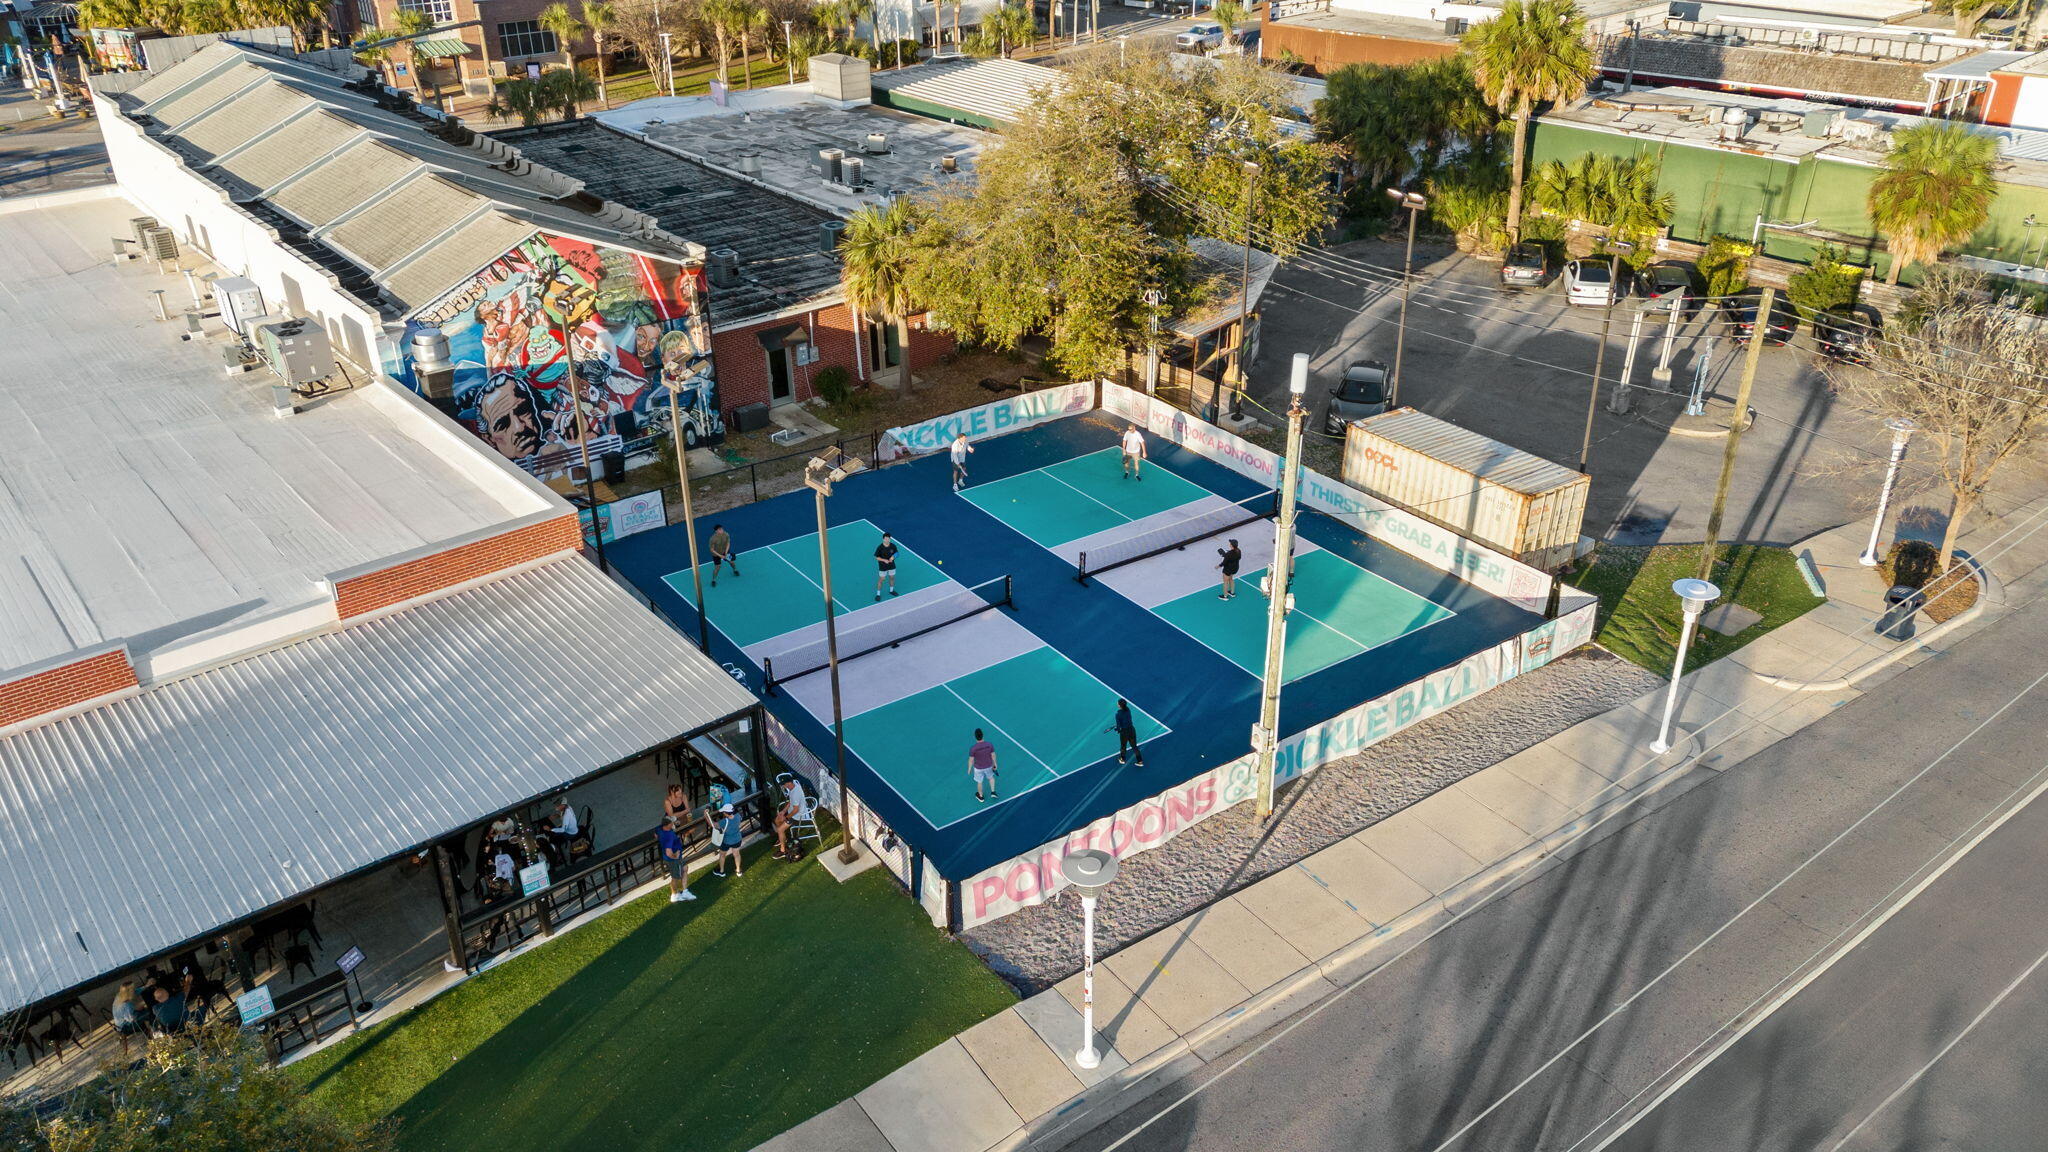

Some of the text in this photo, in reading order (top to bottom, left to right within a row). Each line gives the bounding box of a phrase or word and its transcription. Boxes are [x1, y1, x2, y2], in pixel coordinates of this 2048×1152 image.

[898, 409, 988, 447] ICKLE
[994, 393, 1066, 429] BALL
[1216, 439, 1273, 476] PONTOON!
[1310, 480, 1506, 584] THIRSTY? GRAB A BEER!
[972, 778, 1217, 919] PONTOONS
[1223, 762, 1257, 804] &
